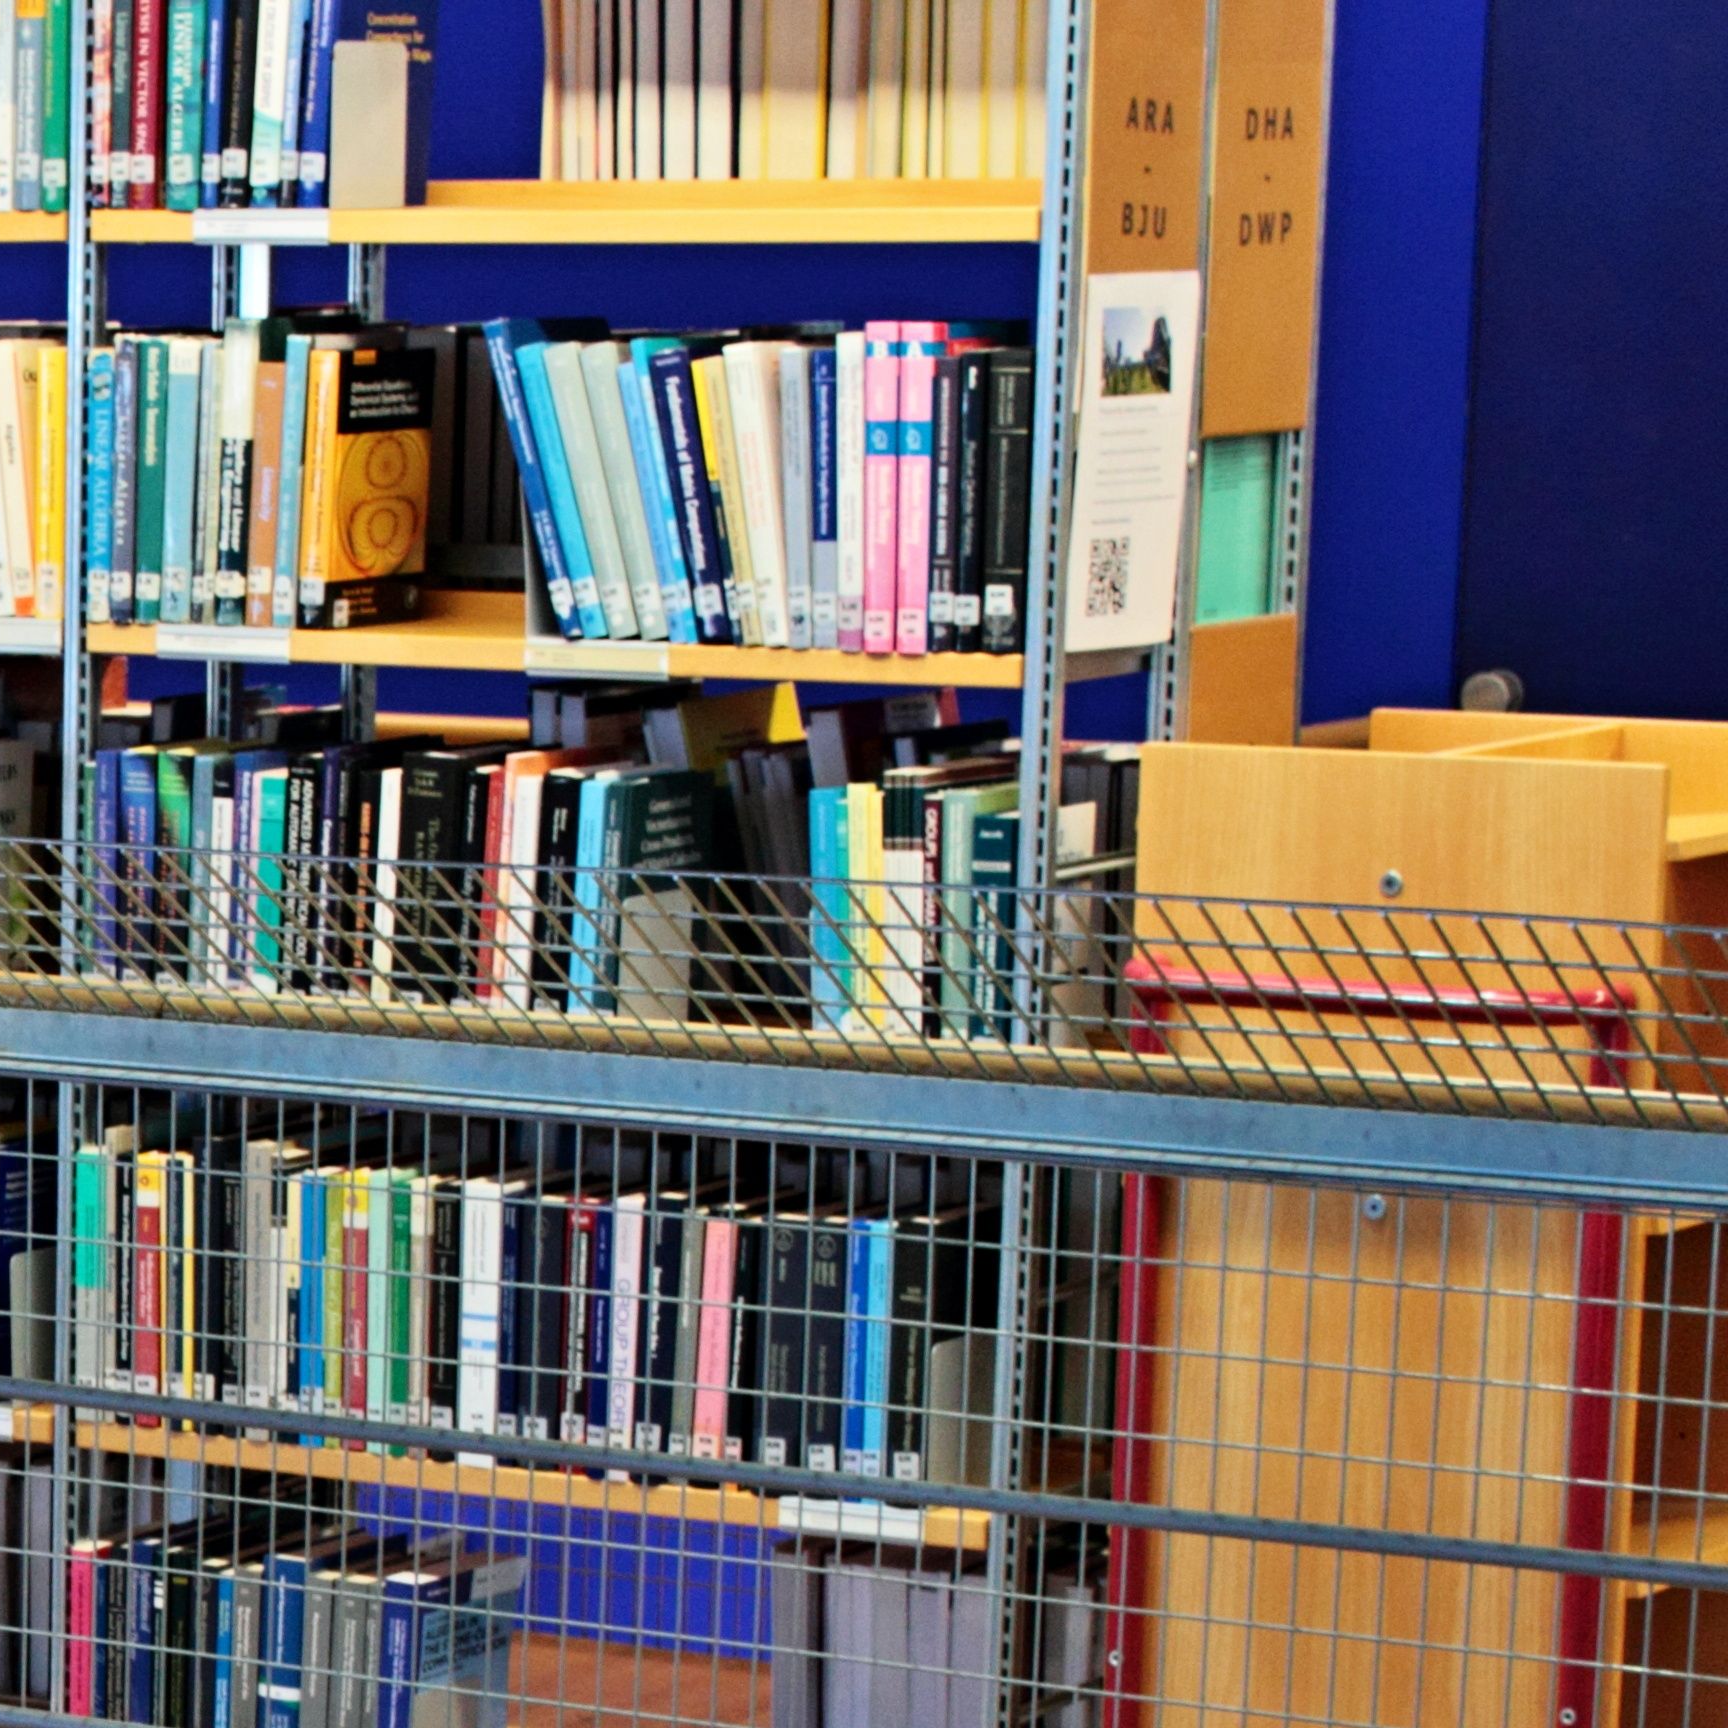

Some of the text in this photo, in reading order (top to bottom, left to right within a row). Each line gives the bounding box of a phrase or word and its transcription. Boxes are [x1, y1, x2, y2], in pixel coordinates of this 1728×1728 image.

[1127, 98, 1173, 133] ARA
[1246, 108, 1292, 140] DHA
[1122, 203, 1165, 239] BJU
[1240, 212, 1291, 246] DWP
[873, 342, 889, 357] B
[906, 342, 923, 357] A
[290, 780, 301, 801] FOR
[301, 780, 314, 839] ADVANCED
[611, 1278, 632, 1428] GROUP THEOR
